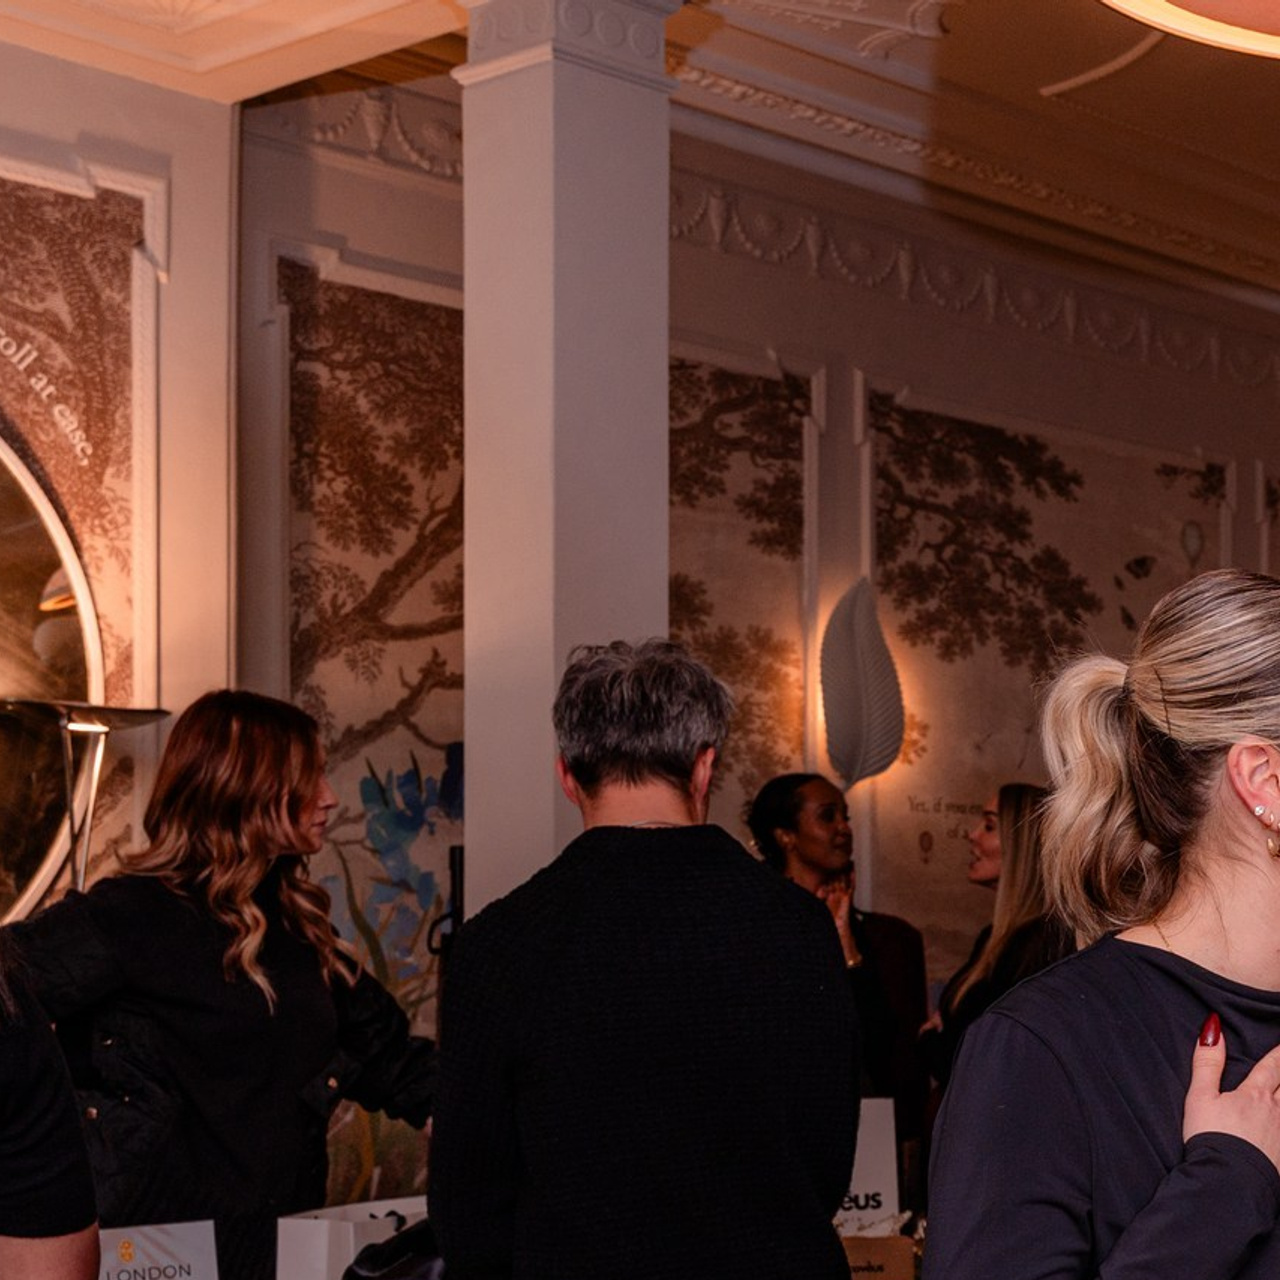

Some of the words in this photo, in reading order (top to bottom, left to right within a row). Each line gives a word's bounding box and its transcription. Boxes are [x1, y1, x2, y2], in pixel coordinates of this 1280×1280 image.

[0, 326, 38, 371] oll
[30, 372, 57, 403] at
[53, 403, 93, 467] ease,
